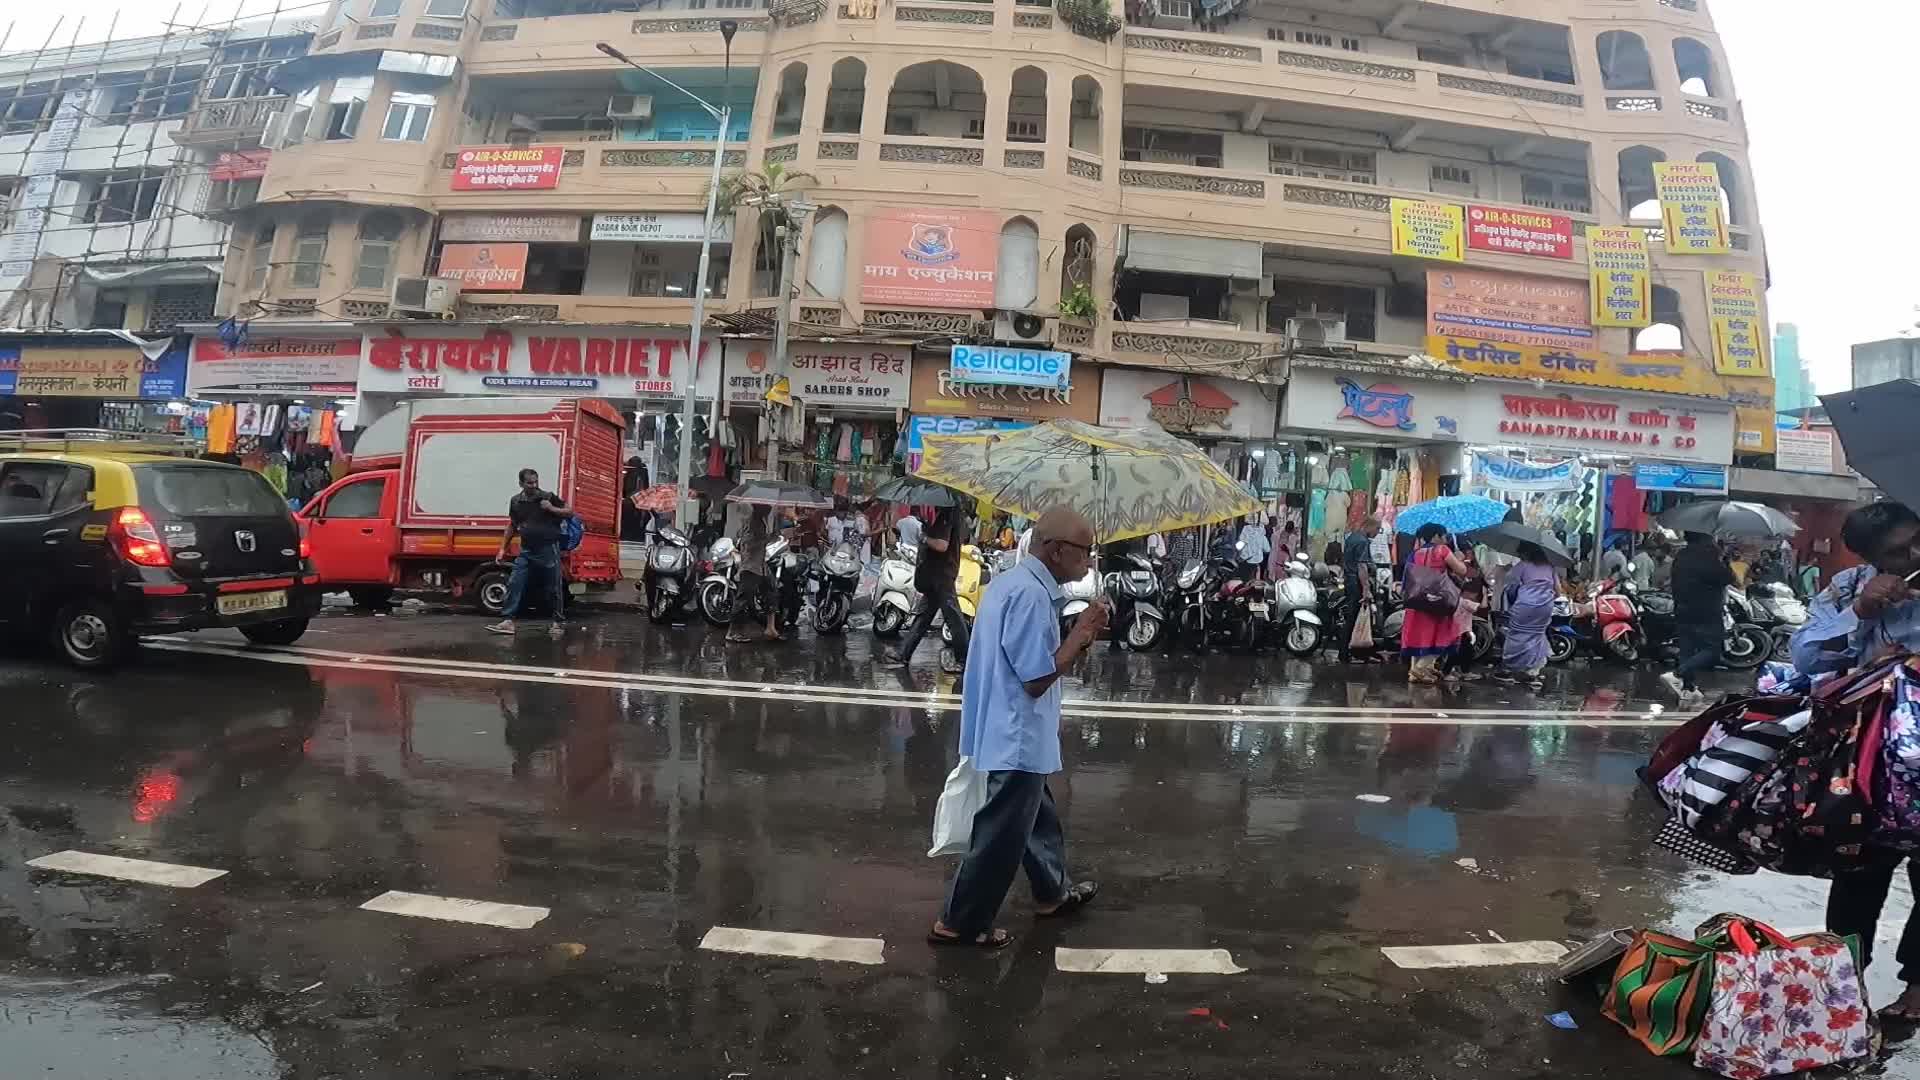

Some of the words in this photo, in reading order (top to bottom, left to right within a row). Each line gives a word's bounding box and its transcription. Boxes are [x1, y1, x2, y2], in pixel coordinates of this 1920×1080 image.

[475, 150, 544, 161] AIR-O-SERVICES
[1485, 210, 1552, 229] AIR-O-SERVICES
[596, 224, 619, 232] DADAR
[620, 224, 639, 232] BOOK
[864, 265, 897, 277] माय
[907, 265, 994, 283] एज्युकेशन
[792, 353, 862, 374] आझाद
[870, 352, 905, 376] हिंद
[954, 347, 1059, 374] Reliable
[486, 378, 506, 386] KIDS,
[635, 380, 672, 391] STORES
[804, 385, 853, 396] SAREES
[857, 387, 890, 397] SHOP
[1498, 420, 1642, 443] SAHASTRAKIRAN
[1650, 434, 1660, 446] &
